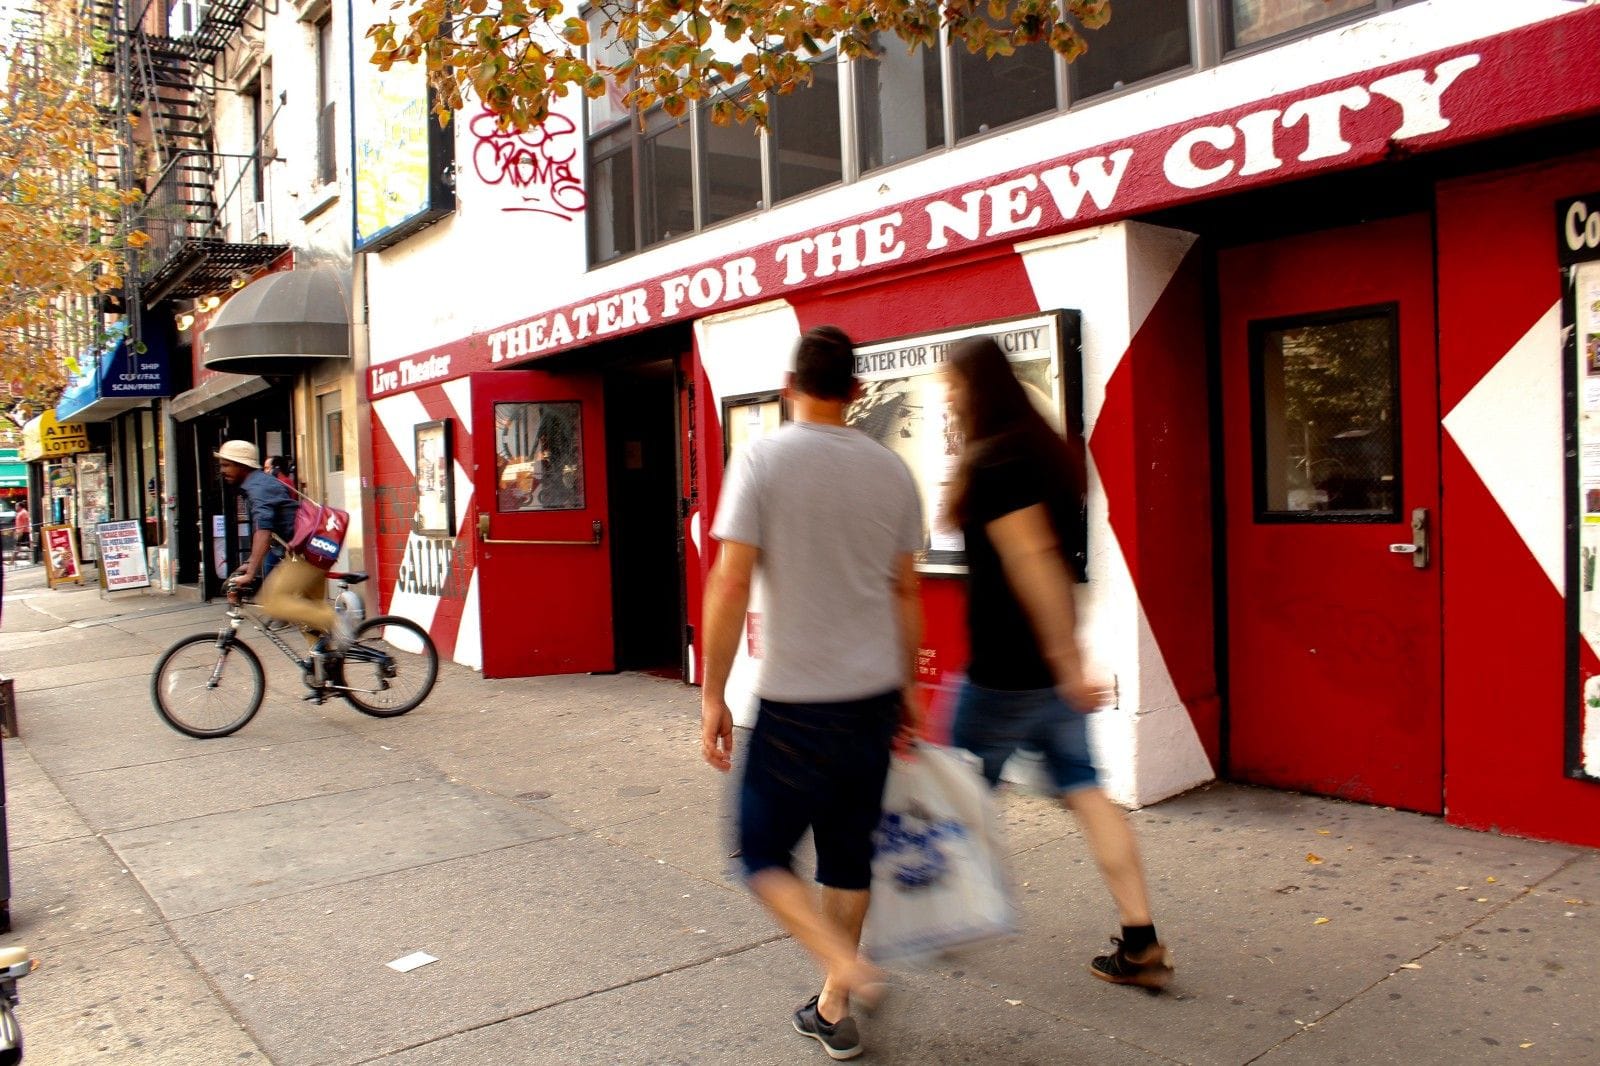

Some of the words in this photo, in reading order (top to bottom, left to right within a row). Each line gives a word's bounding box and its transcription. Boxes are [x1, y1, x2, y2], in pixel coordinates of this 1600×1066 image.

[487, 290, 650, 363] THEATER
[660, 256, 762, 319] FOR
[775, 211, 905, 286] THE
[924, 148, 1133, 251] NEW
[1162, 53, 1481, 190] CITY
[852, 351, 896, 374] EATER
[899, 346, 927, 368] FOR
[930, 343, 952, 363] TH
[1004, 328, 1041, 353] CITY
[112, 383, 161, 391] SCAN/PRINT
[371, 368, 398, 394] Live
[399, 354, 451, 386] Theater
[46, 424, 83, 436] ATM
[44, 440, 85, 452] LOTTO
